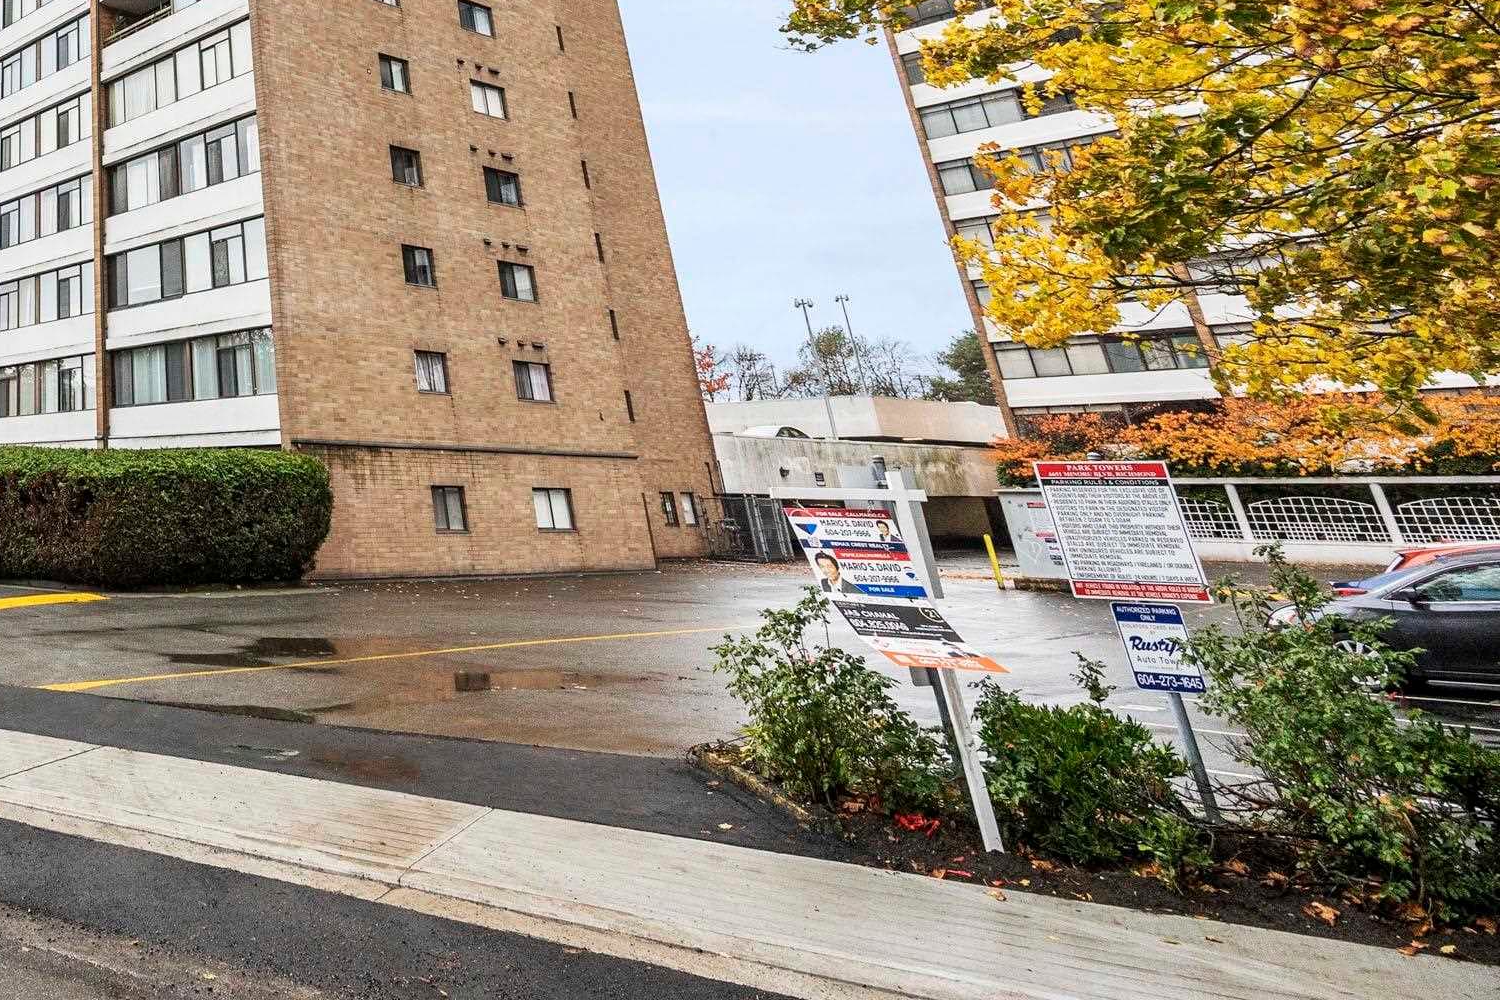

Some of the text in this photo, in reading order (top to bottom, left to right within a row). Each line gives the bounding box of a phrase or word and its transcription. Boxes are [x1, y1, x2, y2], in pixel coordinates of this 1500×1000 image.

[819, 519, 844, 527] MARIO
[851, 520, 874, 528] DAVID
[840, 562, 867, 571] MARIO
[877, 563, 901, 572] DAVID
[1116, 606, 1177, 615] AUTHORIZED PARKING
[1129, 635, 1186, 656] Rustys
[1137, 655, 1157, 664] Auto
[1137, 673, 1203, 690] 604-273-1645
